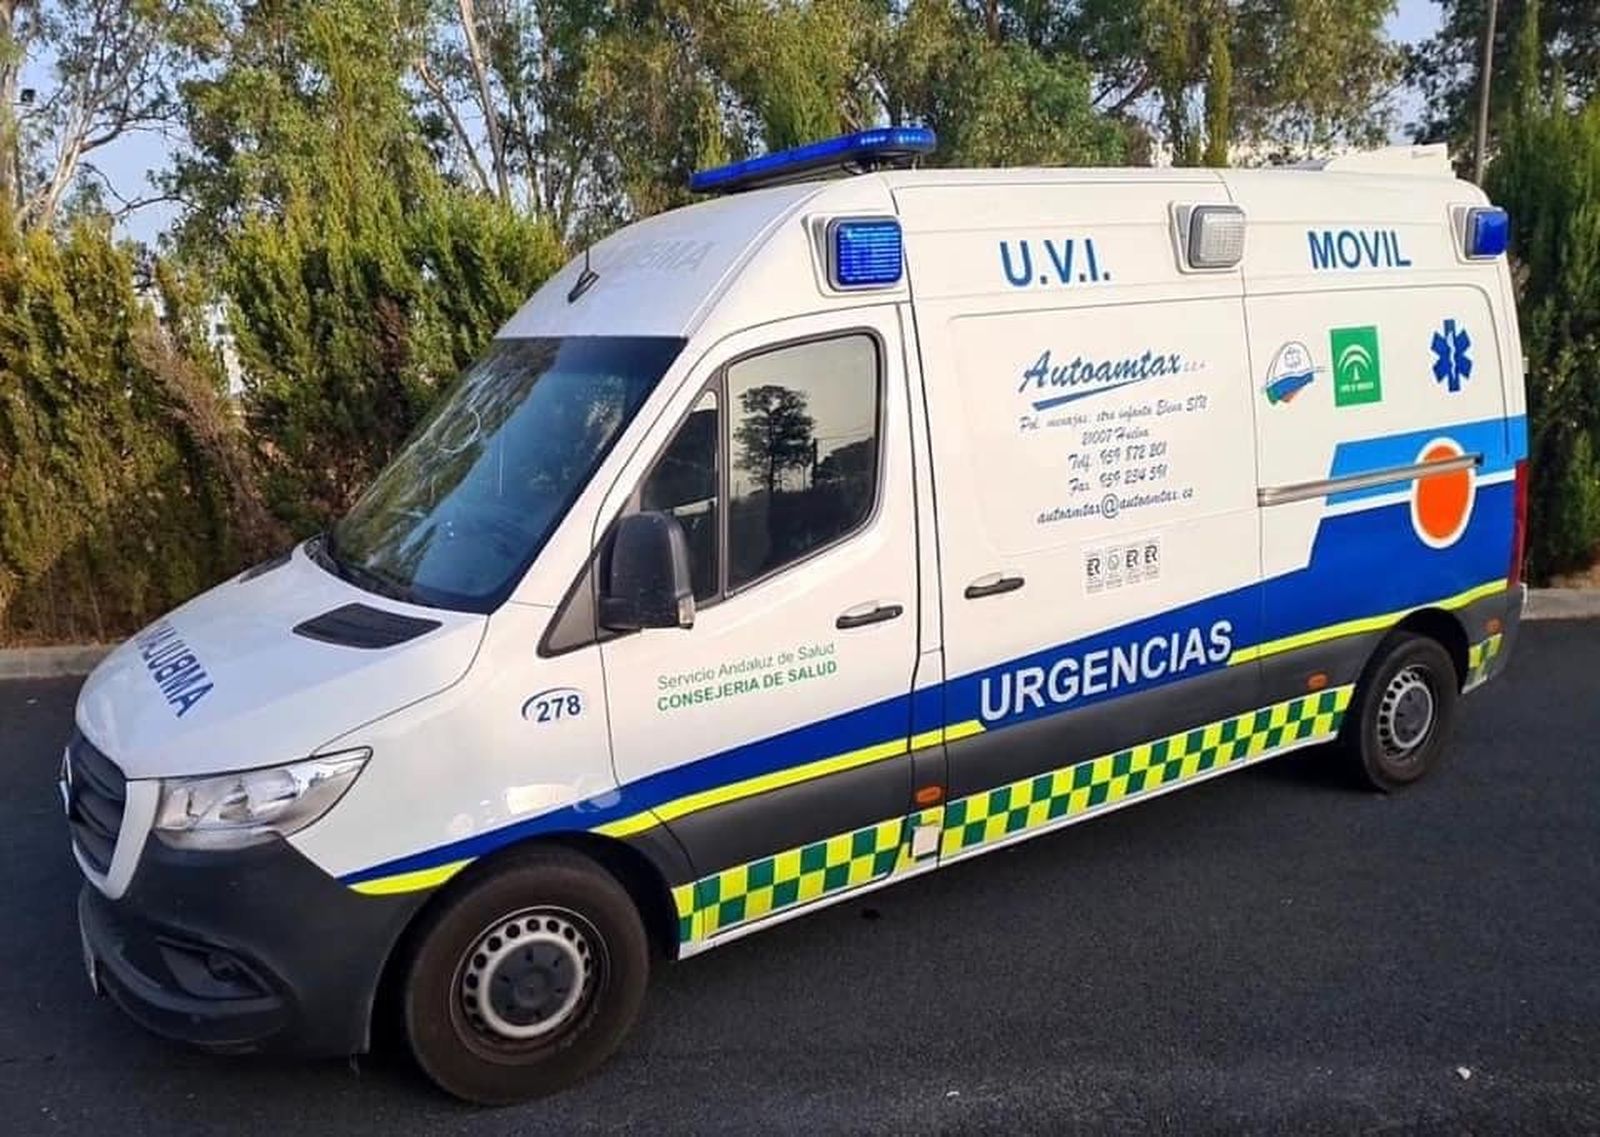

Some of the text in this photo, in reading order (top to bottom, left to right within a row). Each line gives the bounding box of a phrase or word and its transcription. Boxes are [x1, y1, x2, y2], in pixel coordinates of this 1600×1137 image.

[1000, 229, 1412, 286] U.V.I. MOVIL
[1018, 349, 1181, 393] Autoamtax
[1099, 447, 1120, 465] 959
[1099, 470, 1120, 488] 959
[657, 642, 835, 691] Servicio Andaluz de Salud
[657, 660, 838, 712] CONSEJERIA DE SALUD
[981, 620, 1232, 721] URGENCIAS
[536, 694, 582, 723] 278
